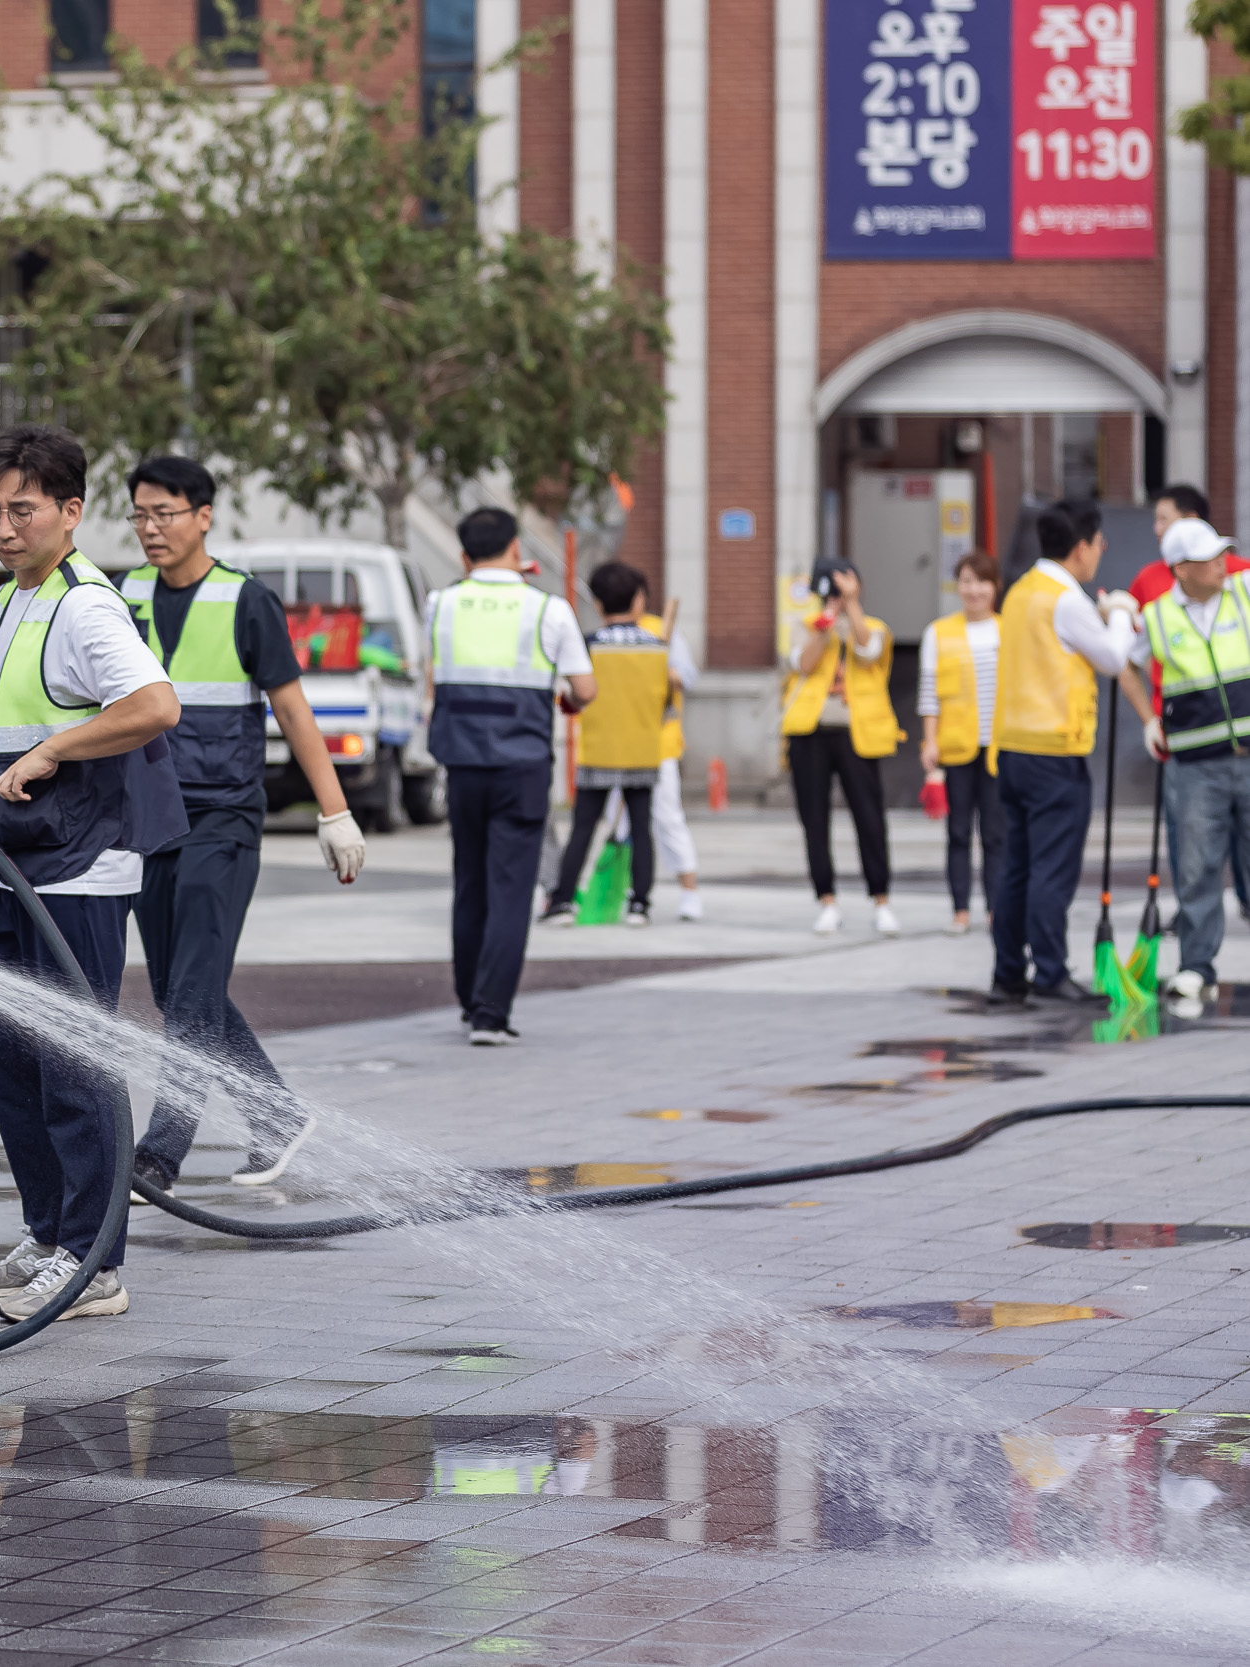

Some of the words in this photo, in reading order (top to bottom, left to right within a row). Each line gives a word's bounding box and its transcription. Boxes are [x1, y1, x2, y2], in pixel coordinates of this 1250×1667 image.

[868, 10, 971, 62] 오후
[1031, 3, 1138, 67] 주일
[862, 61, 981, 117] 2:10
[1036, 65, 1132, 120] 오전
[857, 117, 978, 189] 본당
[1016, 127, 1152, 181] 11:30
